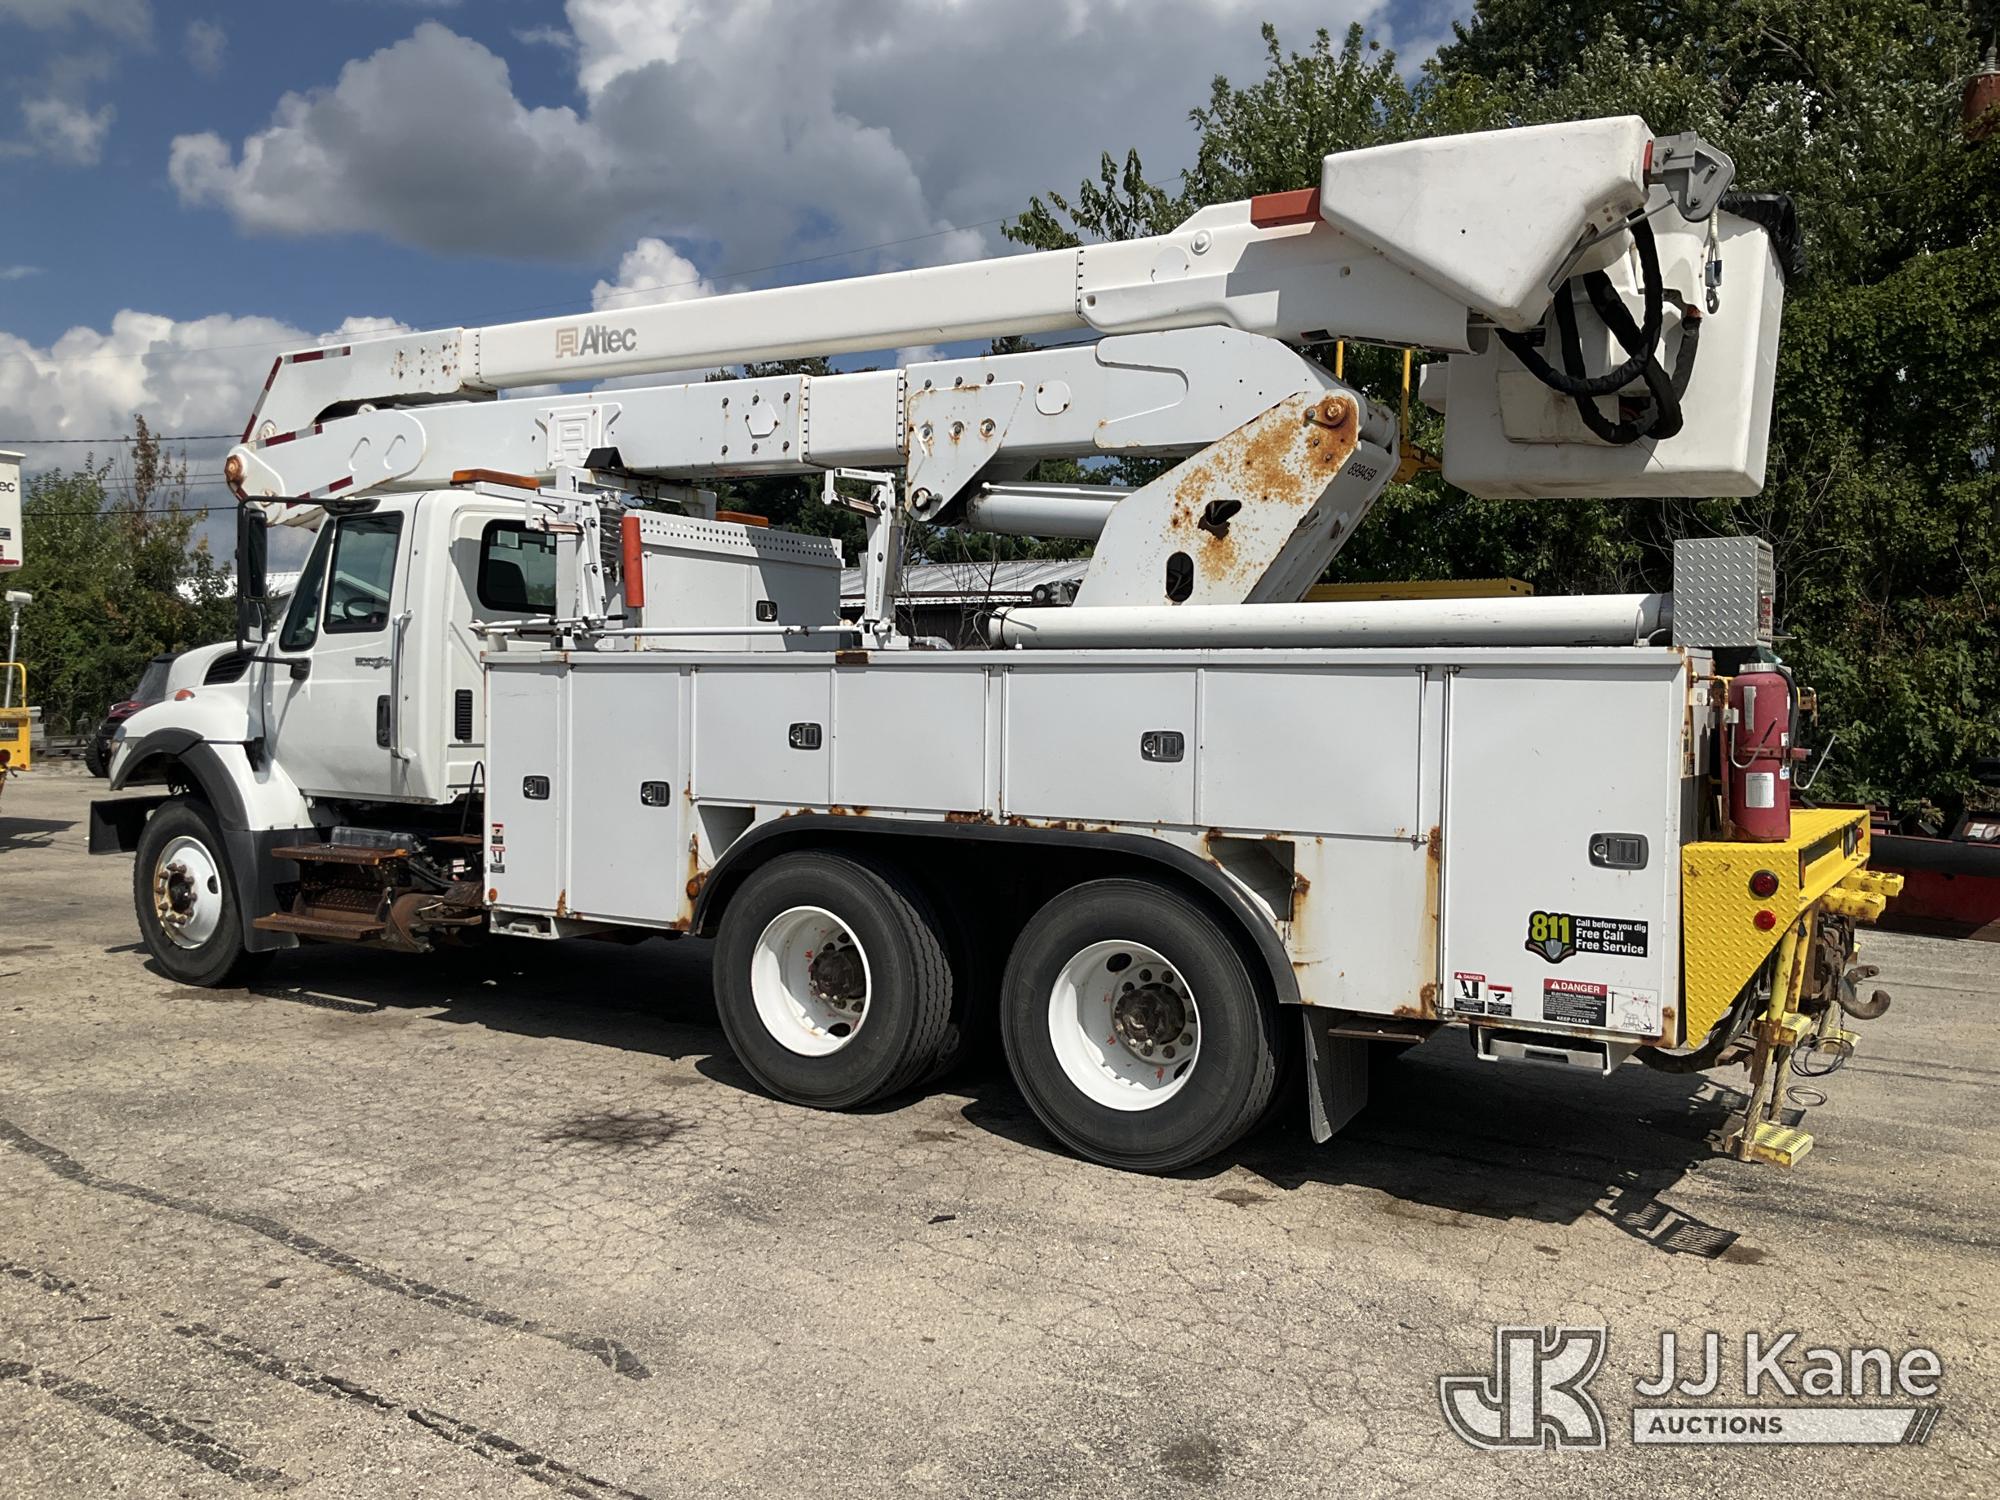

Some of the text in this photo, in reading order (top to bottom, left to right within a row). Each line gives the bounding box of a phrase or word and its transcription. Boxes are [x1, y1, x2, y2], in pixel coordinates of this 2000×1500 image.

[580, 325, 637, 356] Altec
[1531, 913, 1569, 944] 811
[1575, 919, 1647, 933] Call before you dig
[1576, 928, 1624, 941] Free Call
[1576, 939, 1644, 954] Free Service
[1561, 982, 1600, 994] DANGER
